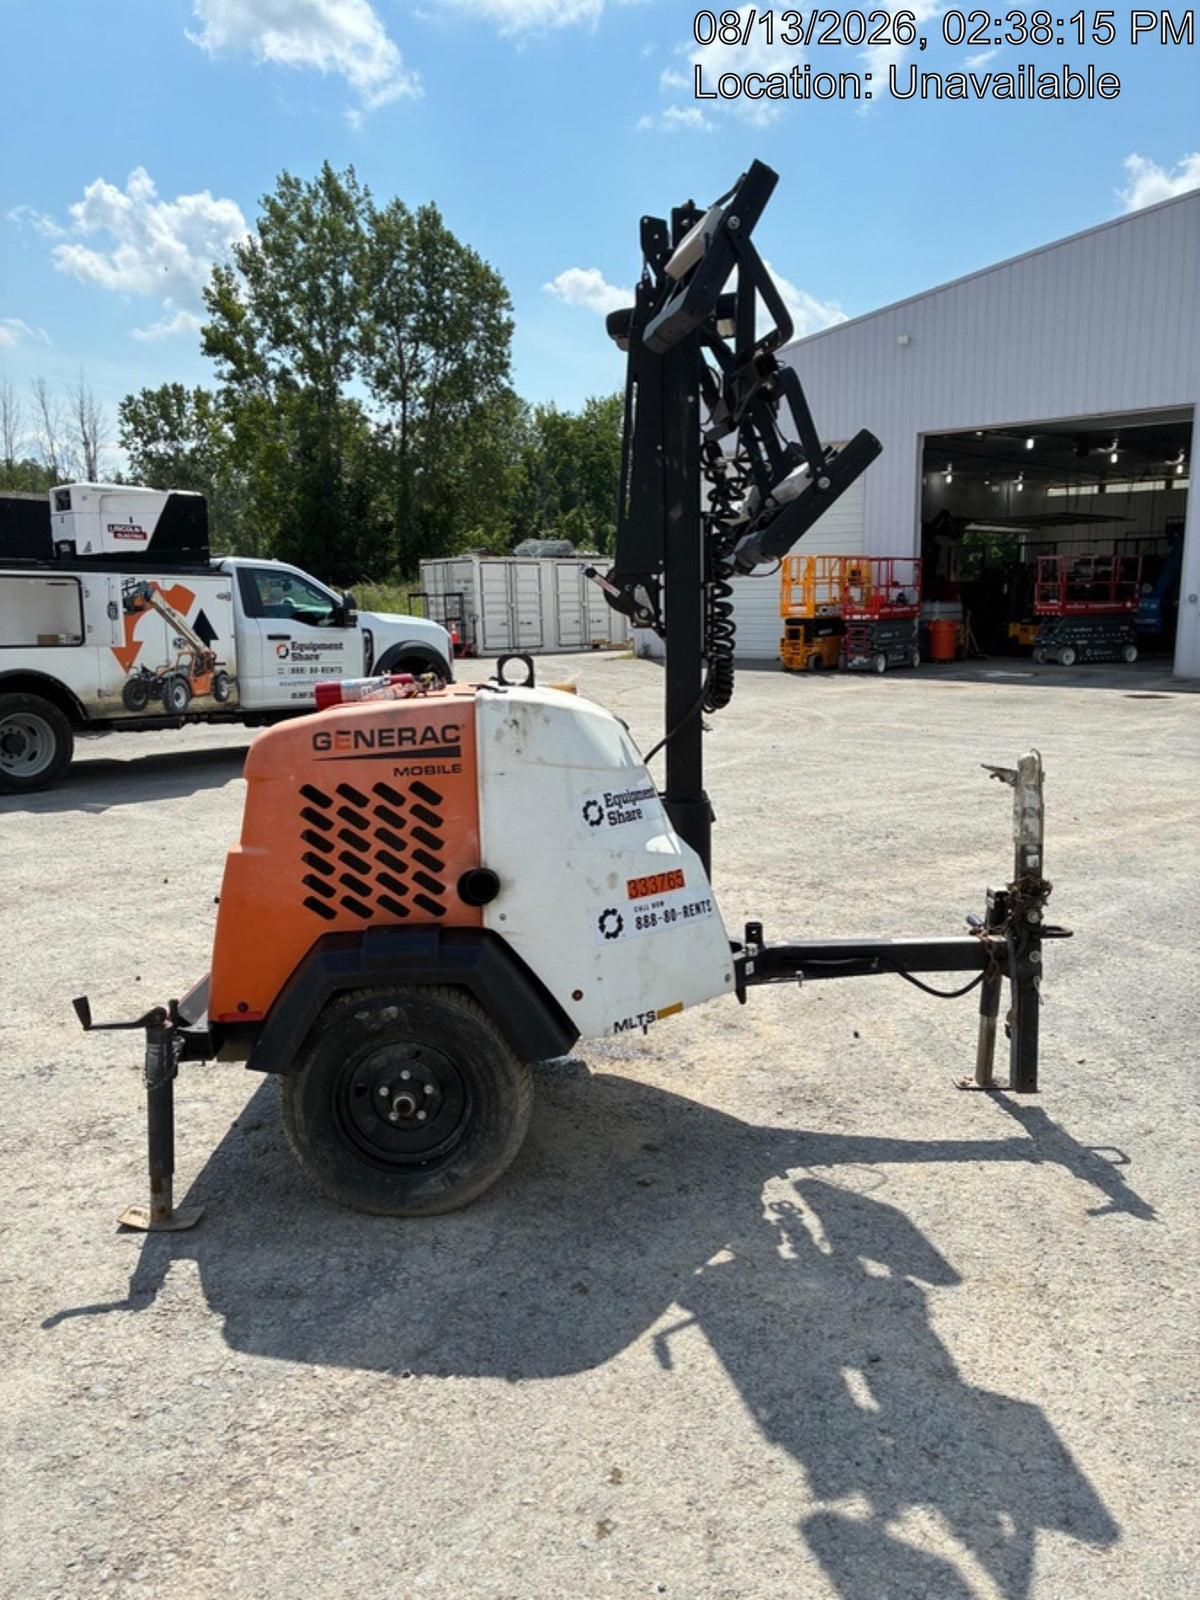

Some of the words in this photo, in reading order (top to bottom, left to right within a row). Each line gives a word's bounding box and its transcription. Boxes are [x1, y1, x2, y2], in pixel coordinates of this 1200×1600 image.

[291, 641, 344, 652] Equipment
[291, 652, 320, 661] Share
[312, 724, 461, 751] GENERAC
[393, 764, 462, 777] MOBILE
[603, 787, 656, 808] Equipment
[607, 808, 643, 826] Share
[627, 869, 686, 899] 333765
[635, 899, 712, 930] 888-80-RENTS
[613, 1009, 656, 1034] MLTS
